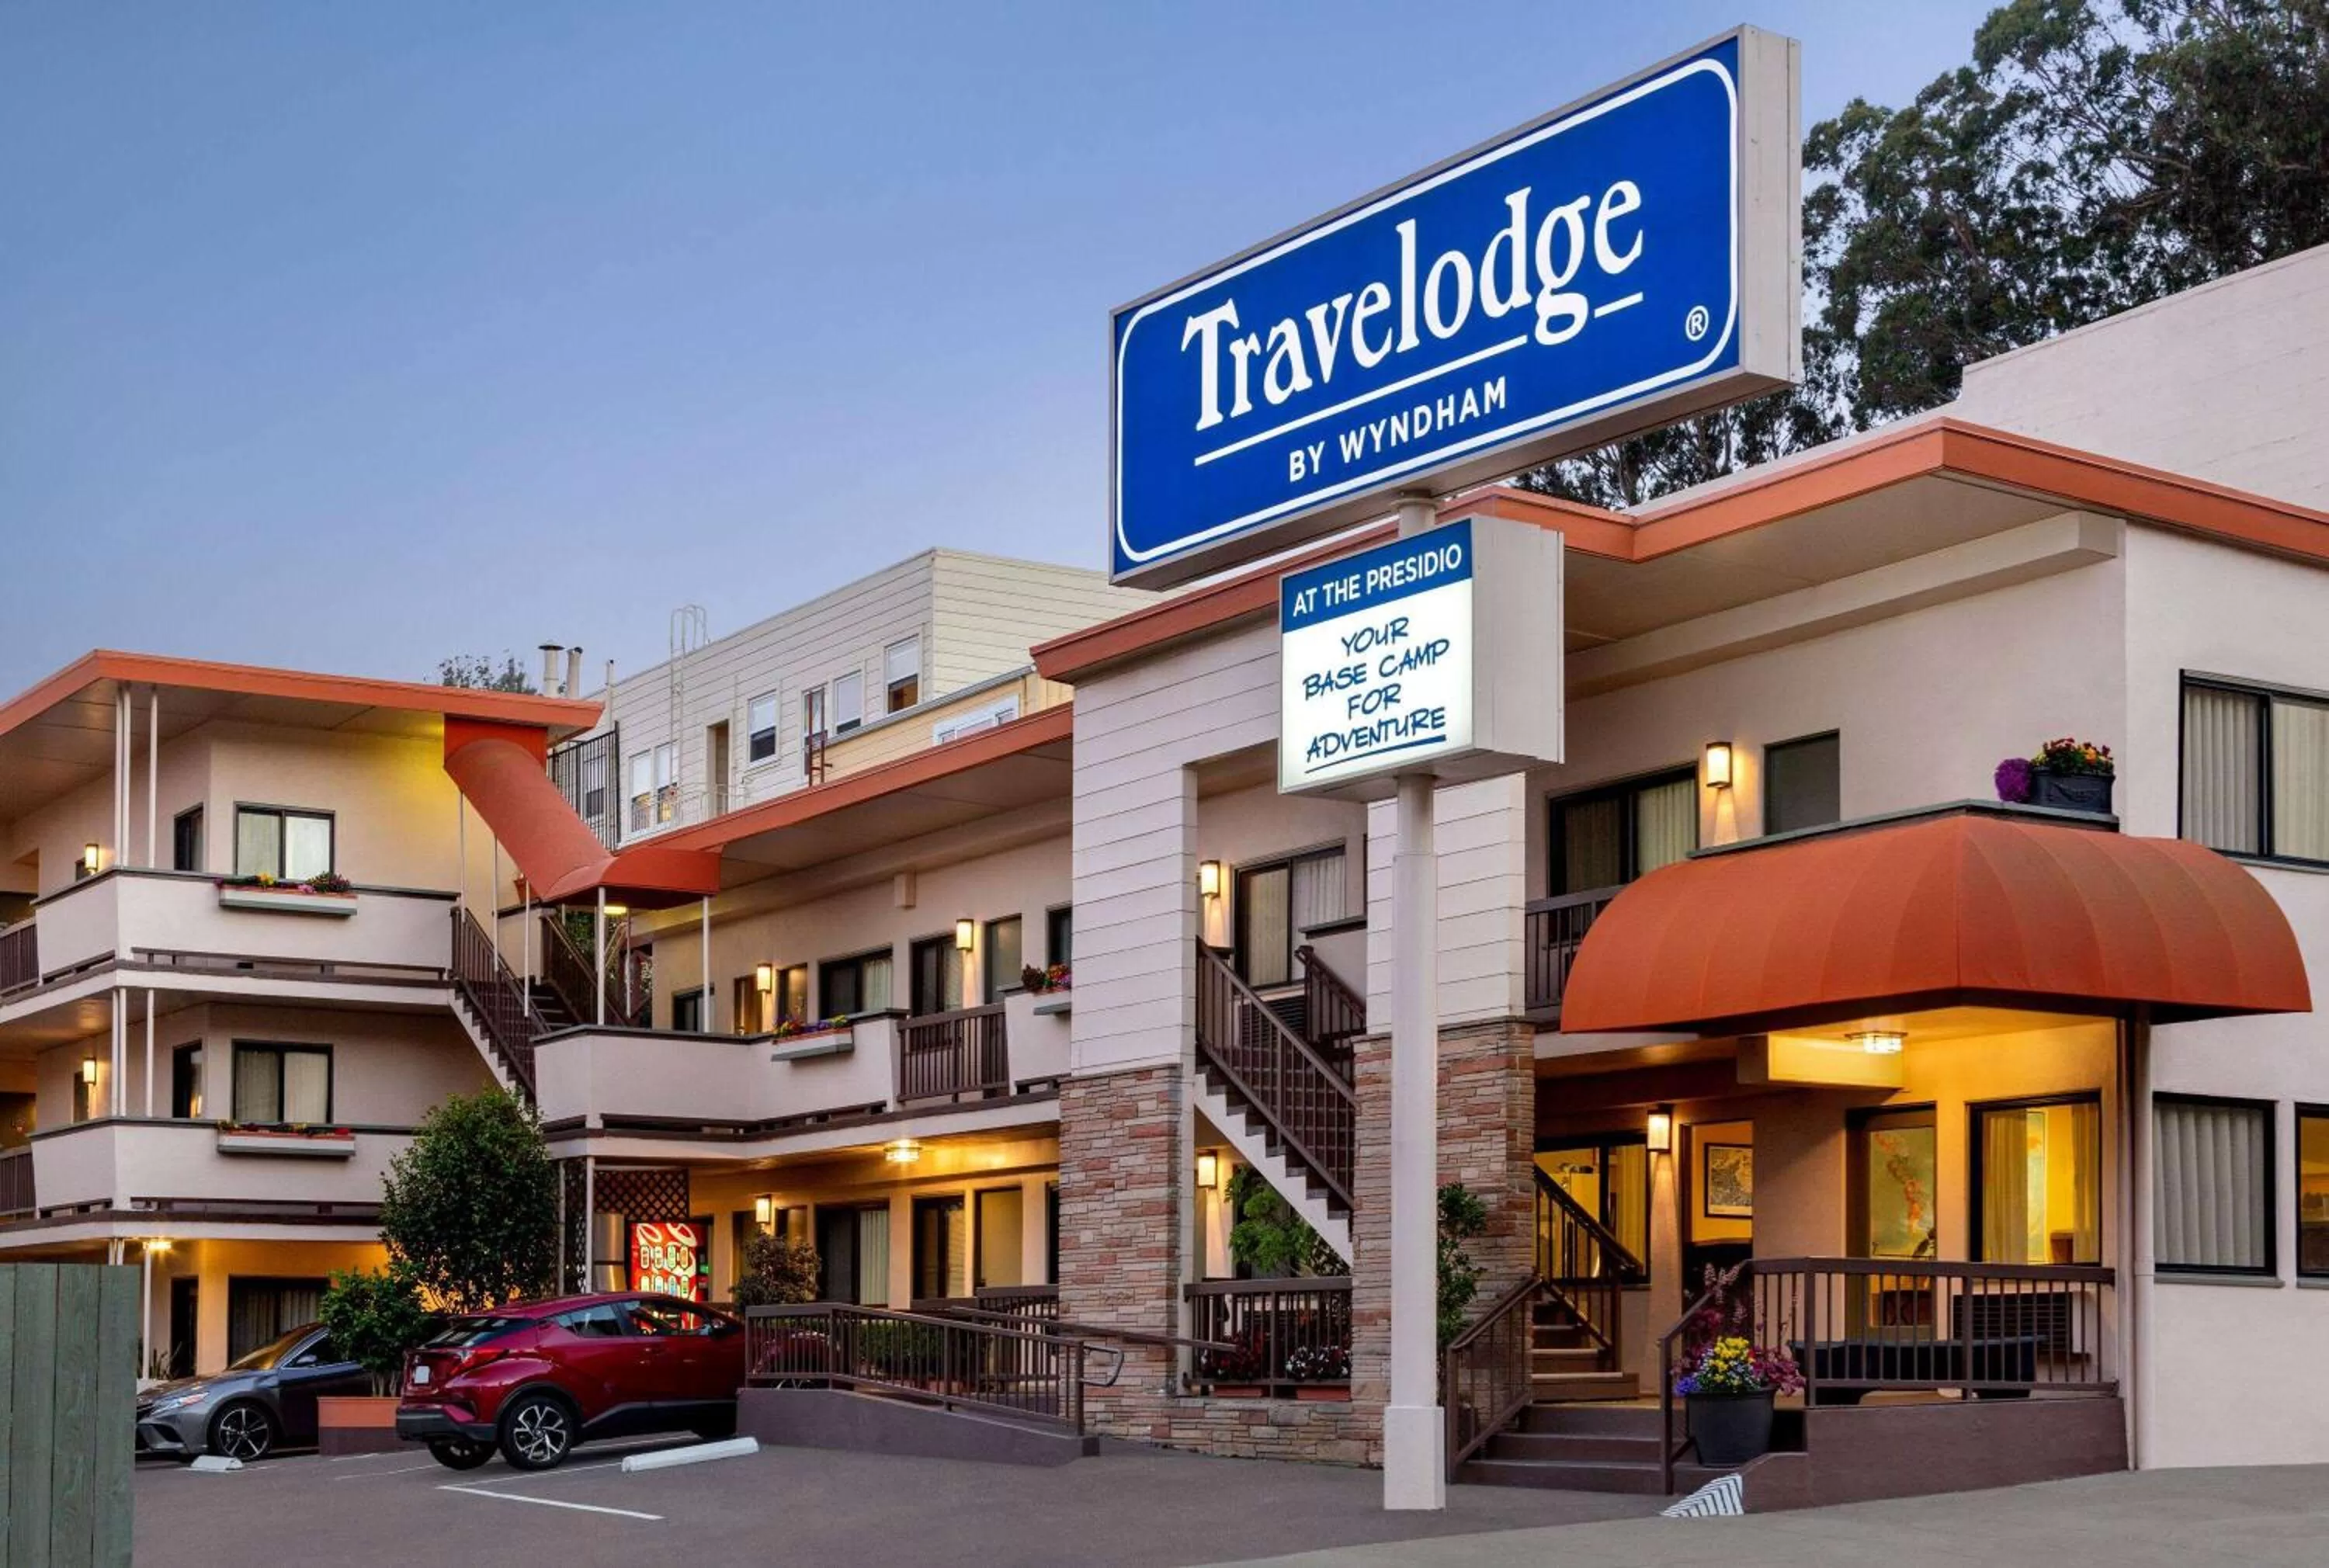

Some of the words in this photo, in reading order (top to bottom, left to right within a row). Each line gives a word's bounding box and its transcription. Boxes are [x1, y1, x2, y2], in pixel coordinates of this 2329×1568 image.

[1181, 179, 1643, 432] Travelodge
[1289, 441, 1325, 482] BY
[1339, 376, 1506, 464] WYNDHAM
[1293, 588, 1317, 617] AT
[1322, 574, 1361, 606] THE
[1366, 543, 1462, 595] PRESIDIO
[1341, 616, 1410, 657] YOUR
[1302, 663, 1368, 701] BASE
[1378, 638, 1450, 678] CAMP
[1347, 683, 1401, 720] FOR
[1306, 706, 1446, 763] ADVENTURE
